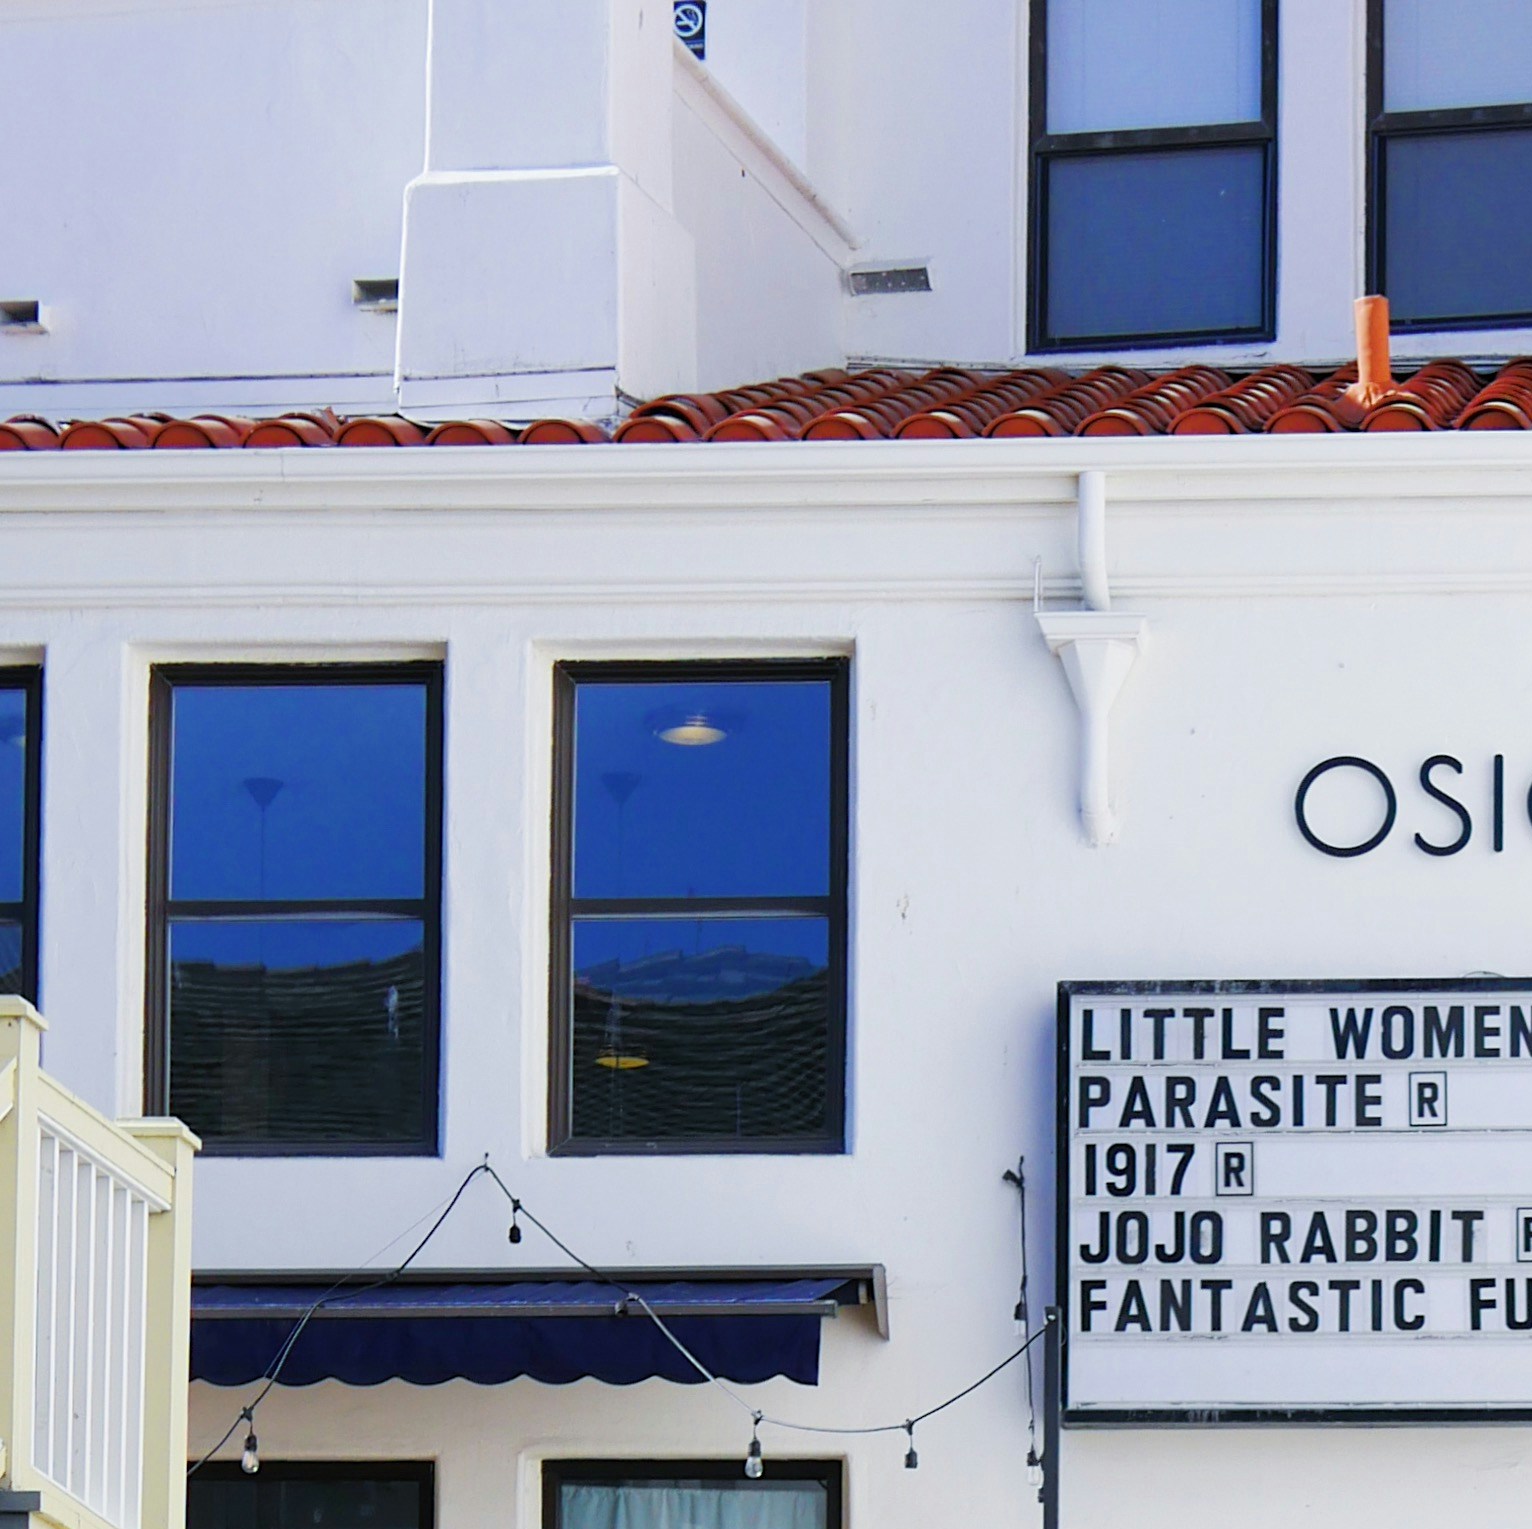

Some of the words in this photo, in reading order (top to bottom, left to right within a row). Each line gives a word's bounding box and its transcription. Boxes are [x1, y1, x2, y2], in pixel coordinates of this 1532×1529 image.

[1081, 1007, 1285, 1061] LITTLE
[1079, 1074, 1382, 1129] PARASITE
[1417, 1082, 1439, 1118] R
[1085, 1142, 1195, 1198] 1917
[1223, 1151, 1245, 1188] R
[1079, 1210, 1224, 1265] JOJO
[1260, 1209, 1484, 1265] RABBIT
[1080, 1278, 1425, 1334] FANTASTIC
